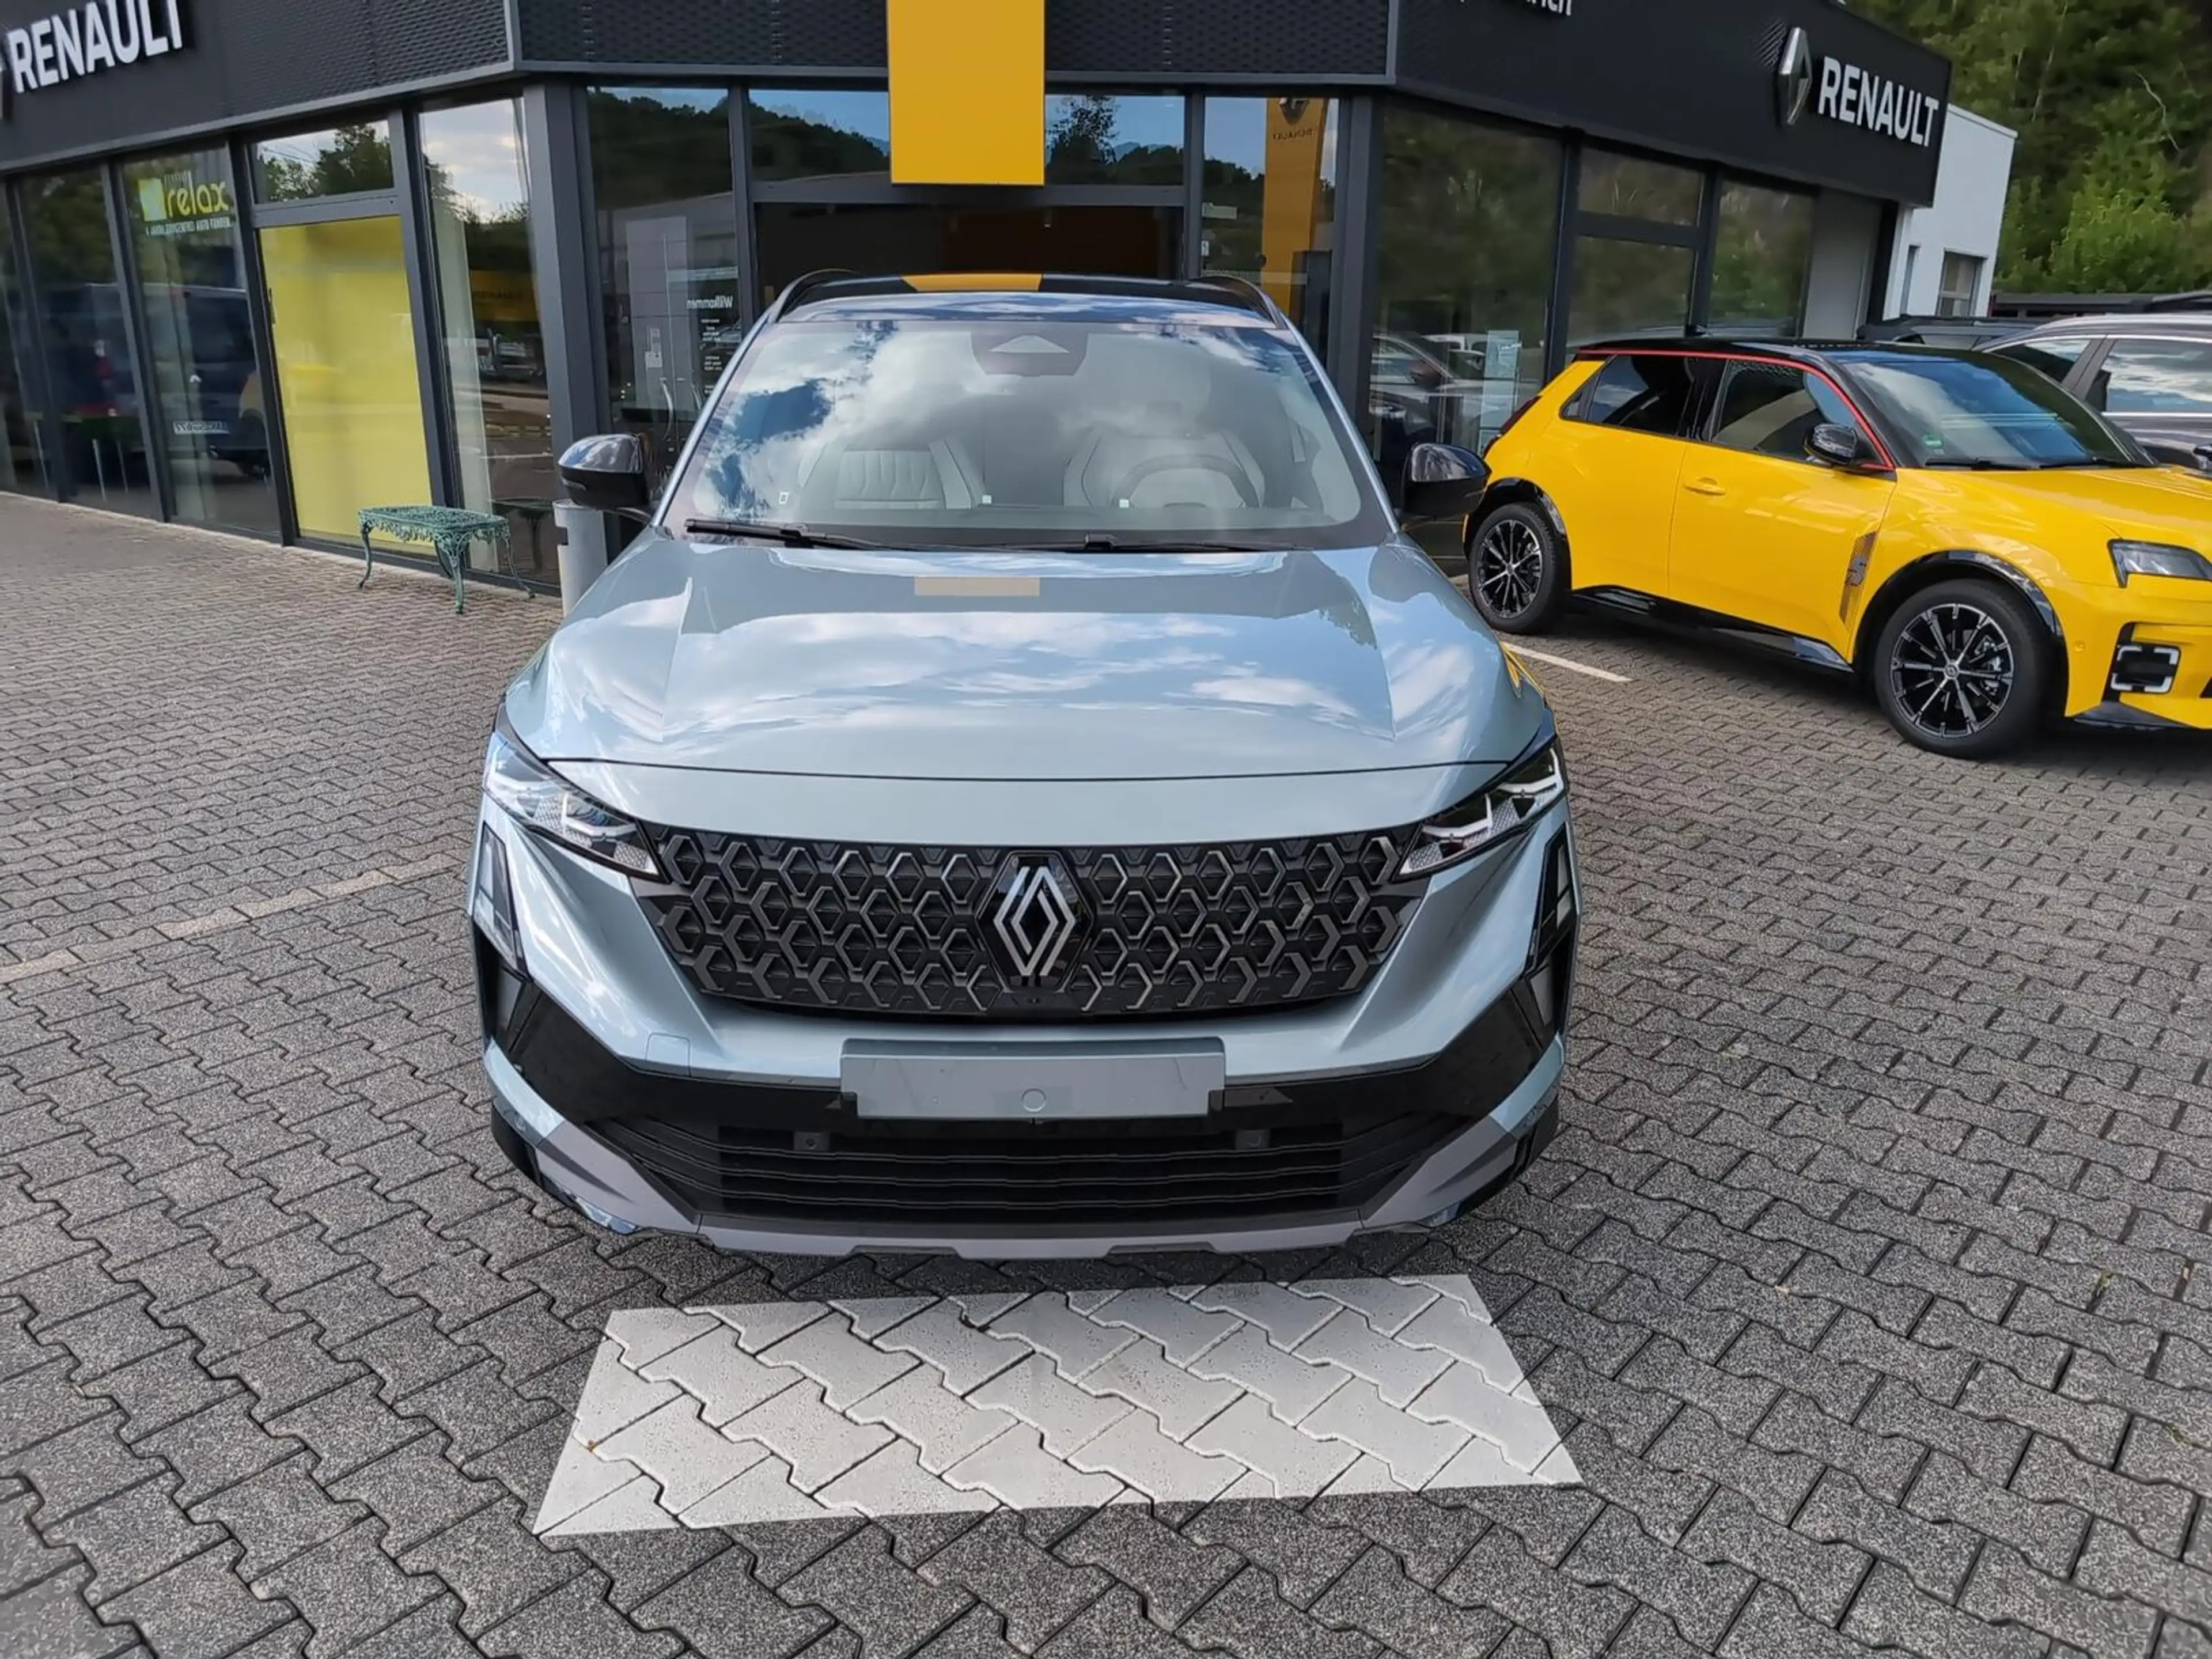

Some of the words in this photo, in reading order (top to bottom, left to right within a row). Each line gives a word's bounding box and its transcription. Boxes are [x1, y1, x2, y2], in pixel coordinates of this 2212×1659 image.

[7, 0, 183, 93] RENAULT
[1818, 56, 1939, 147] RENAULT
[167, 170, 229, 218] relax
